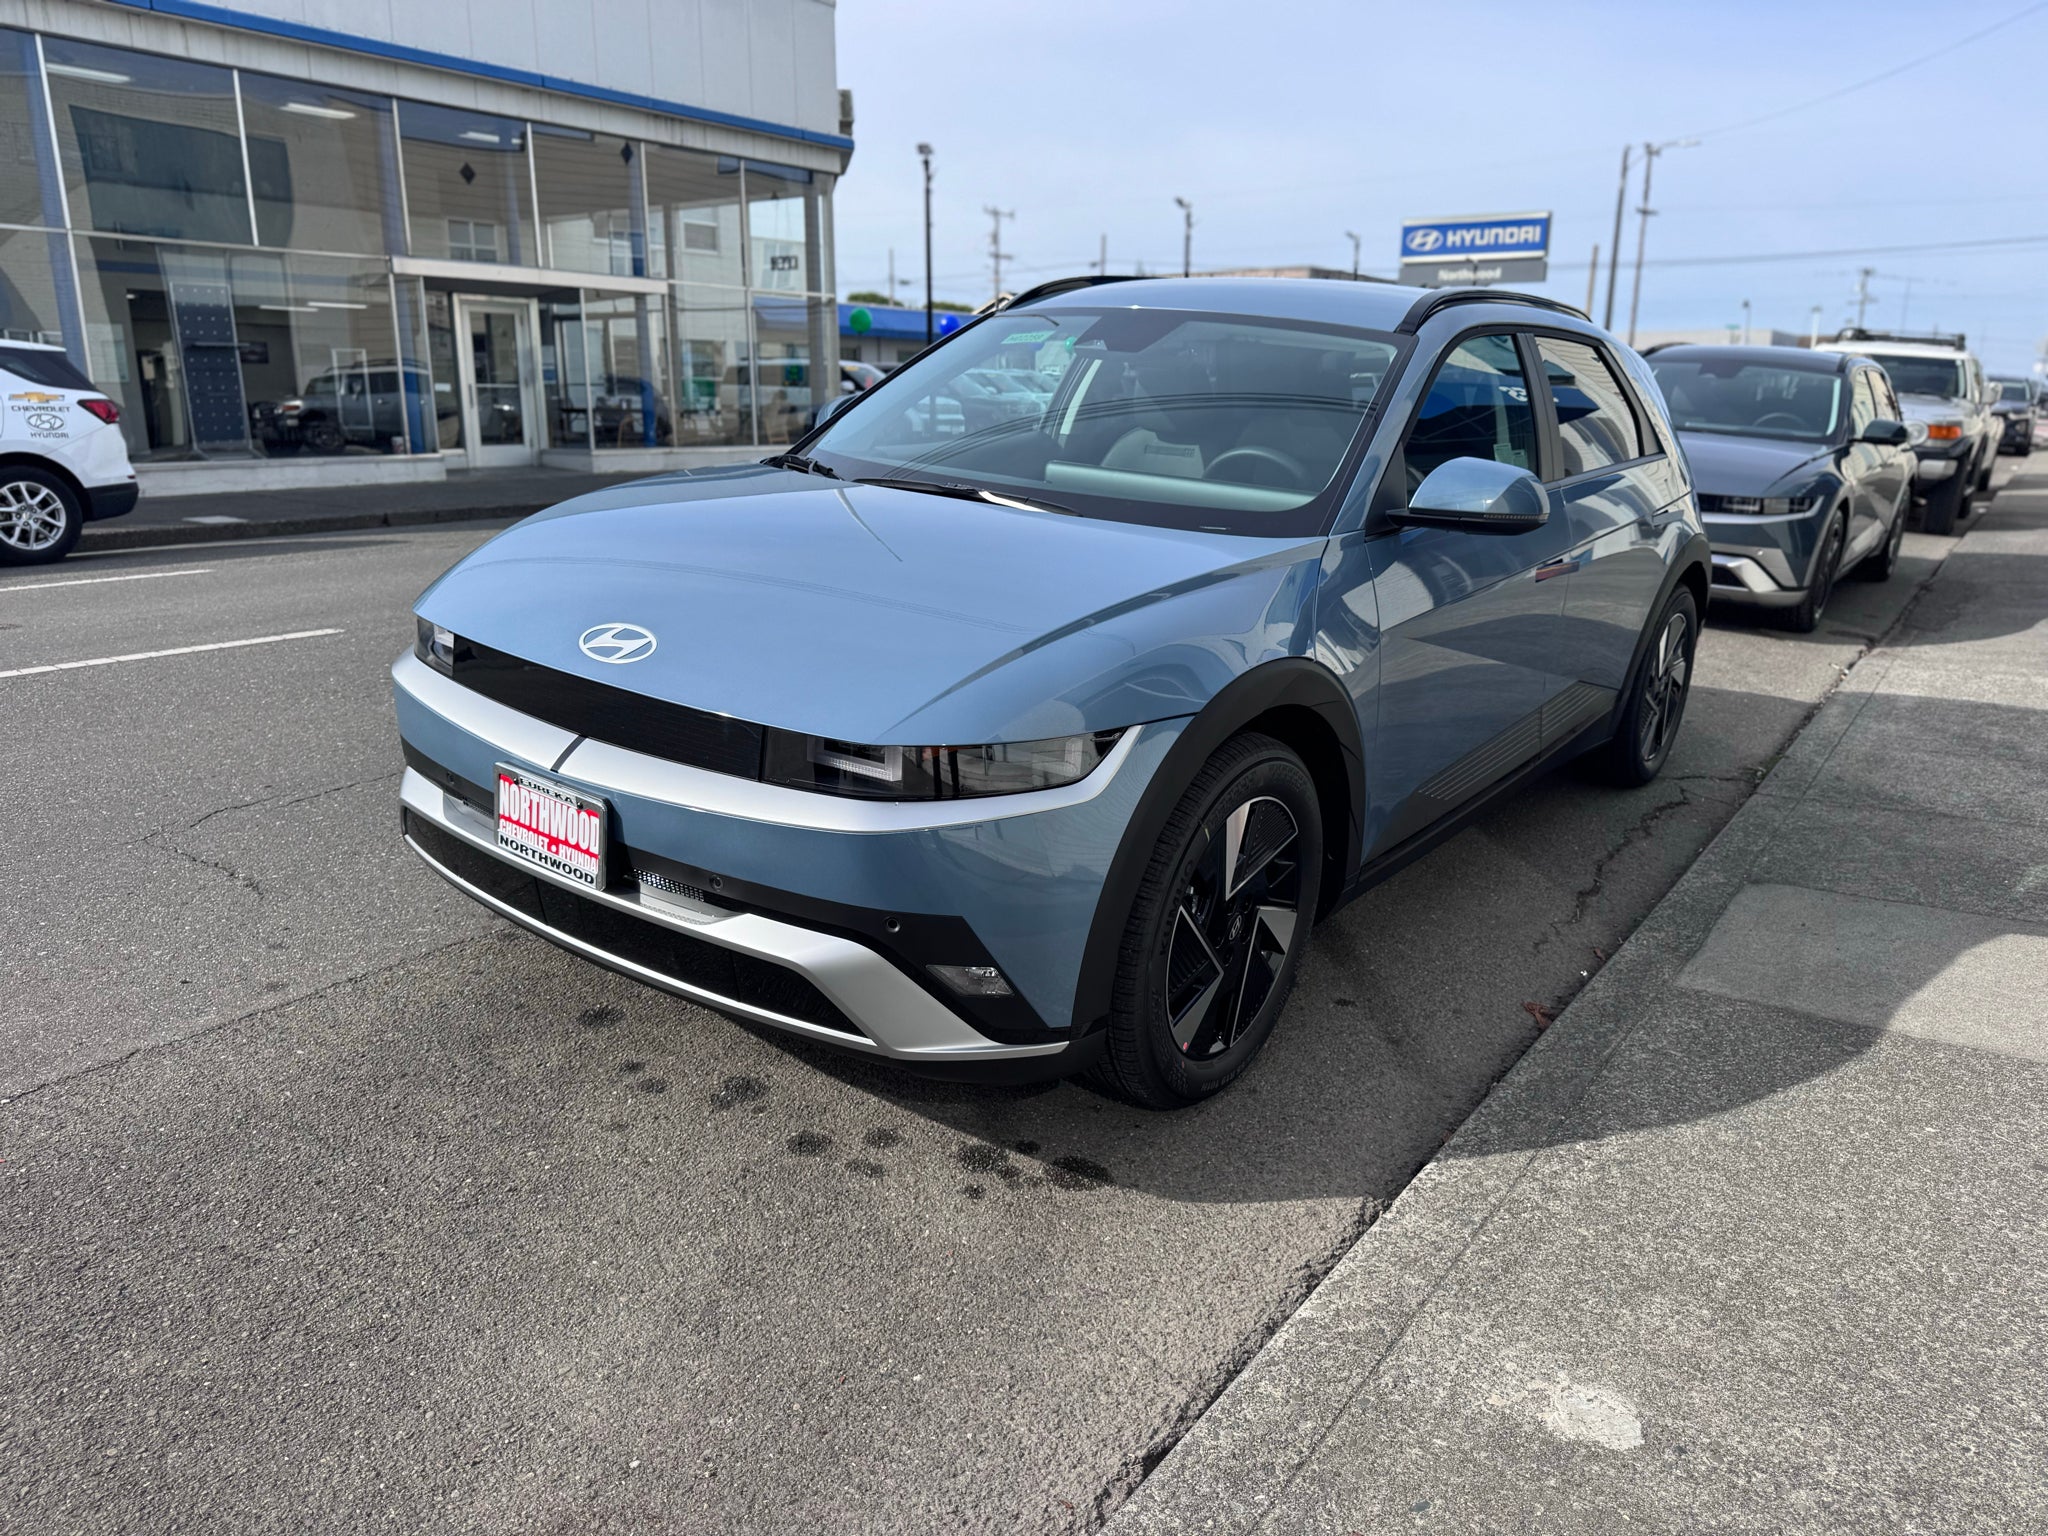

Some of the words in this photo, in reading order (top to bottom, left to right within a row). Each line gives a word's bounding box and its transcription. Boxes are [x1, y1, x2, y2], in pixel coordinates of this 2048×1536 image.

[1446, 226, 1542, 247] HYUNDAI
[11, 405, 70, 413] CHEVROLET
[30, 431, 70, 439] HYUNDAI
[500, 779, 599, 855] NORTHWOOD
[500, 819, 549, 850] CHEVROLET
[500, 834, 594, 884] NORTHWOOD
